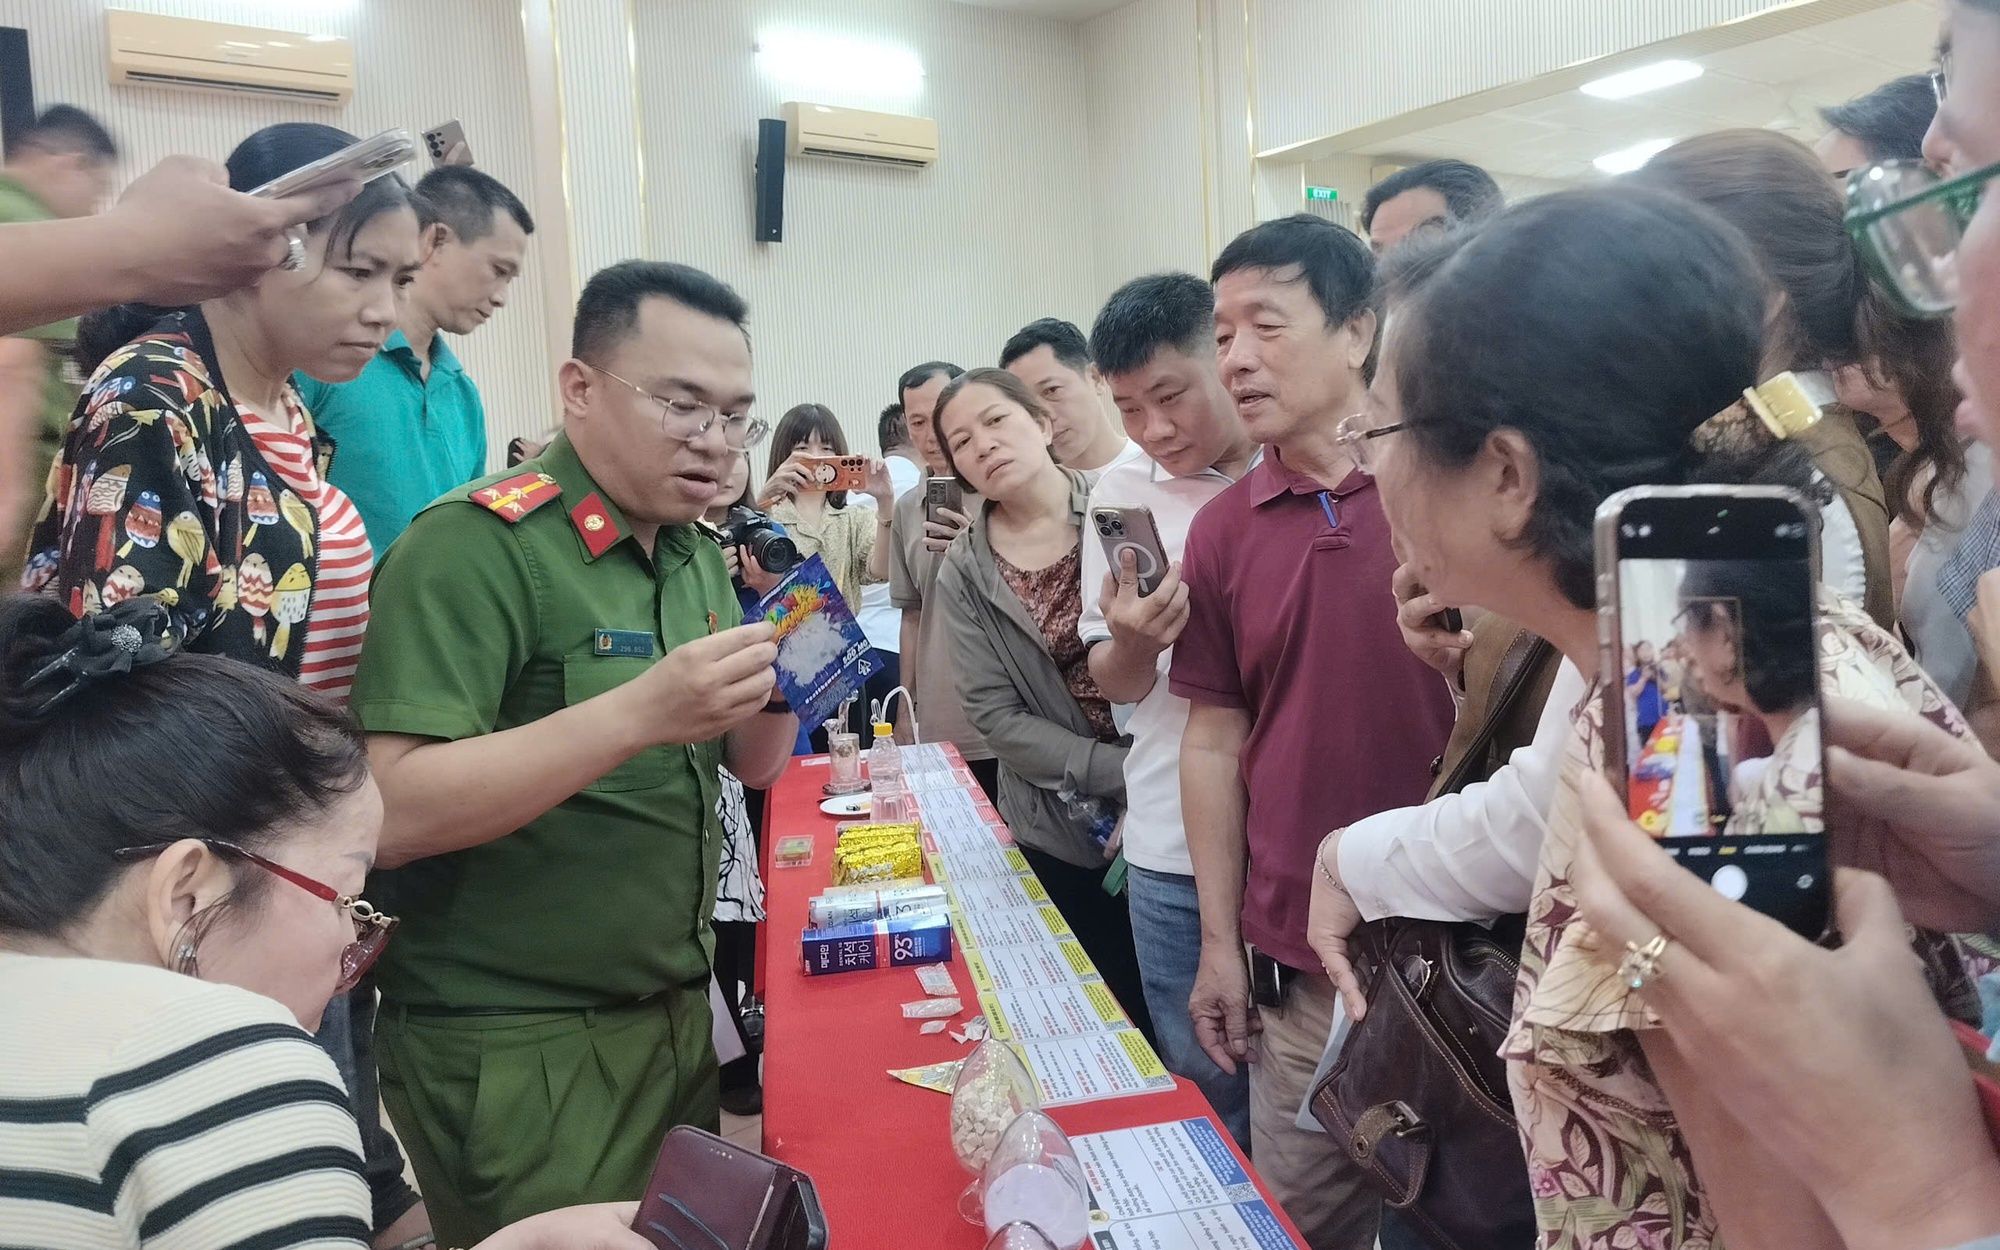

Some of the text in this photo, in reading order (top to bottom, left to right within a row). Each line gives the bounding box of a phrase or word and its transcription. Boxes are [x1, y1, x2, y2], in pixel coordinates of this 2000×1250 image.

[1313, 189, 1331, 199] EXIT
[843, 650, 858, 664] 500
[820, 944, 830, 968] 메디안
[844, 941, 857, 965] 치석
[858, 939, 871, 963] 케어
